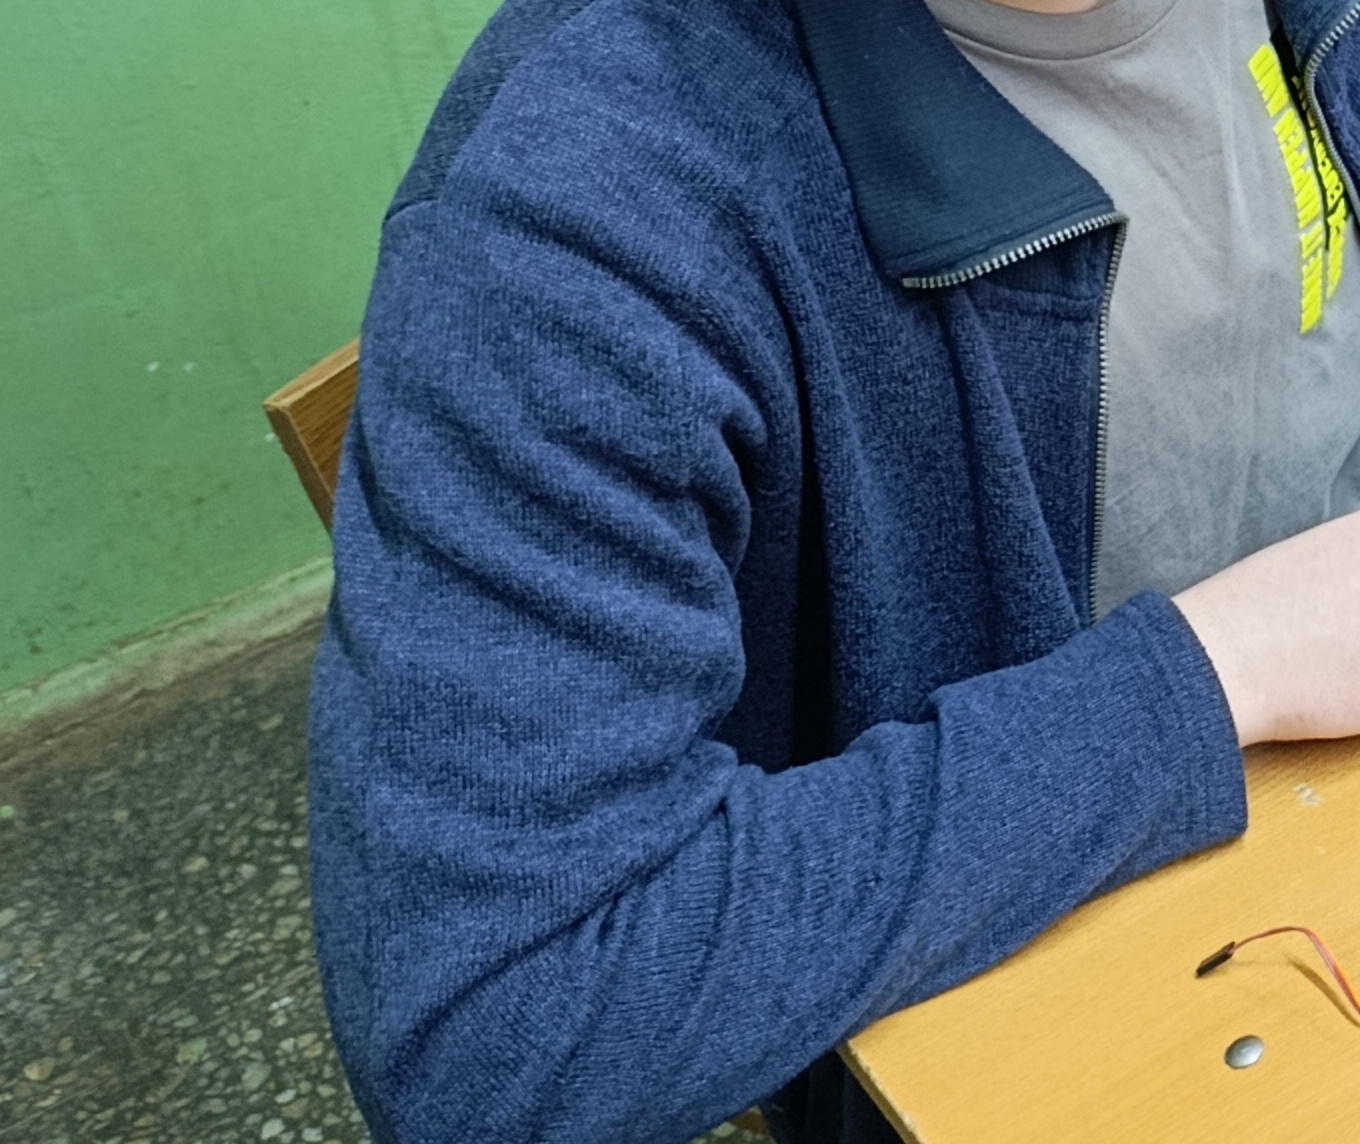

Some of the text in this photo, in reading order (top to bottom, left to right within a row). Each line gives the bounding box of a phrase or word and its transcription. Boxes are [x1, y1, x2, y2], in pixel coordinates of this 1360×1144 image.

[1248, 45, 1289, 116] AND
[1273, 108, 1320, 228] HAPPEN
[1300, 222, 1322, 258] IT
